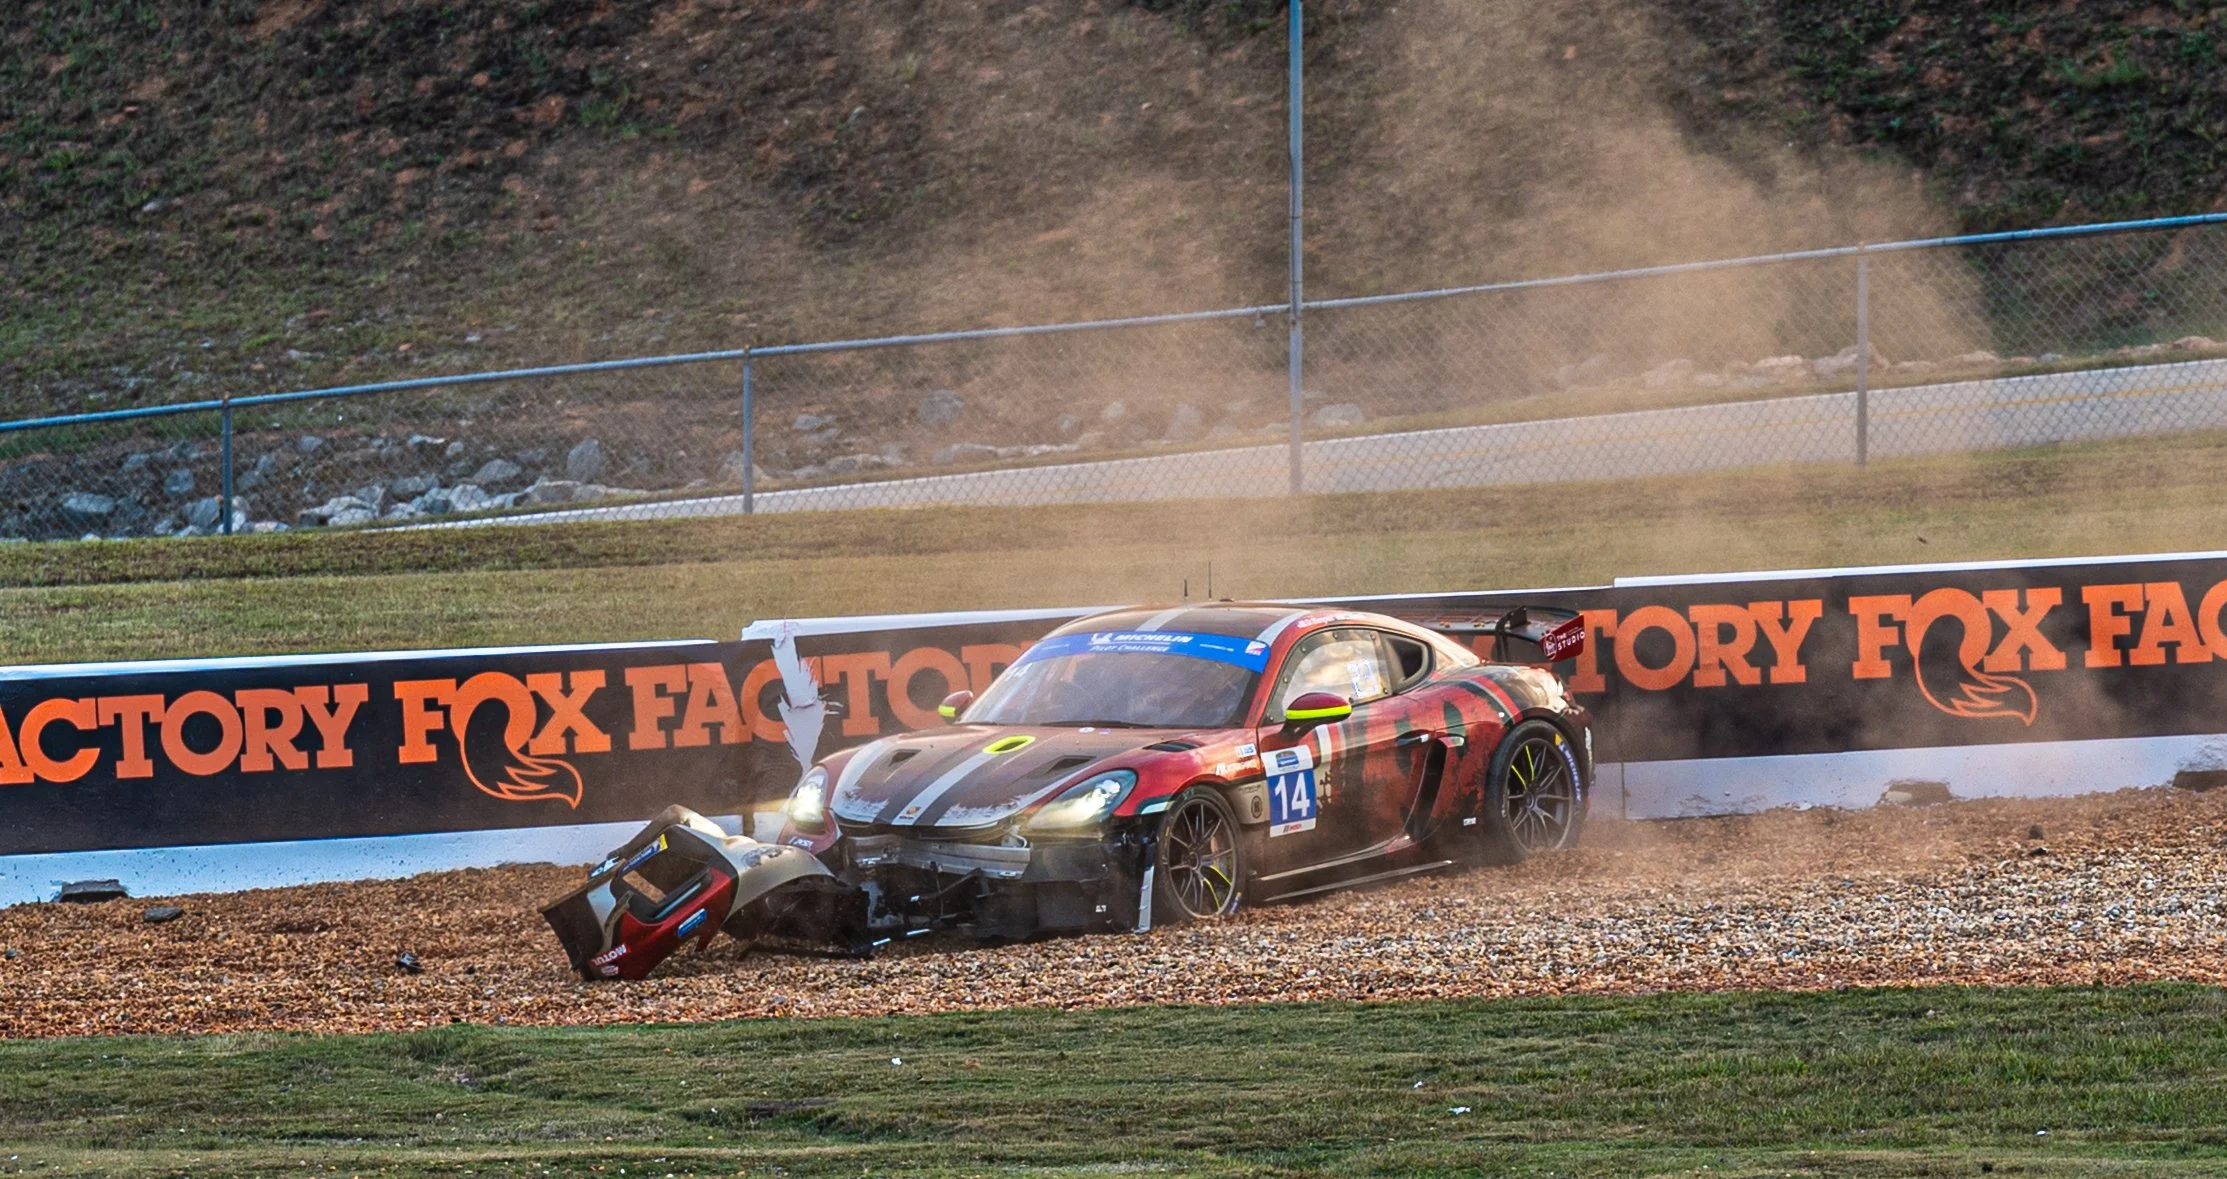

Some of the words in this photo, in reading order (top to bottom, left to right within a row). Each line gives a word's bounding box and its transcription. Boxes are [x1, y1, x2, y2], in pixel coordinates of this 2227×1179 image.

[1113, 633, 1194, 643] MICHELIN
[1437, 599, 1823, 694] TORY
[1848, 586, 2068, 727] FOX
[1557, 631, 1586, 651] STUDIO
[394, 669, 611, 809] FOX
[624, 640, 1036, 749] FACTOR
[1274, 771, 1311, 821] 14
[591, 943, 628, 967] MOTUL
